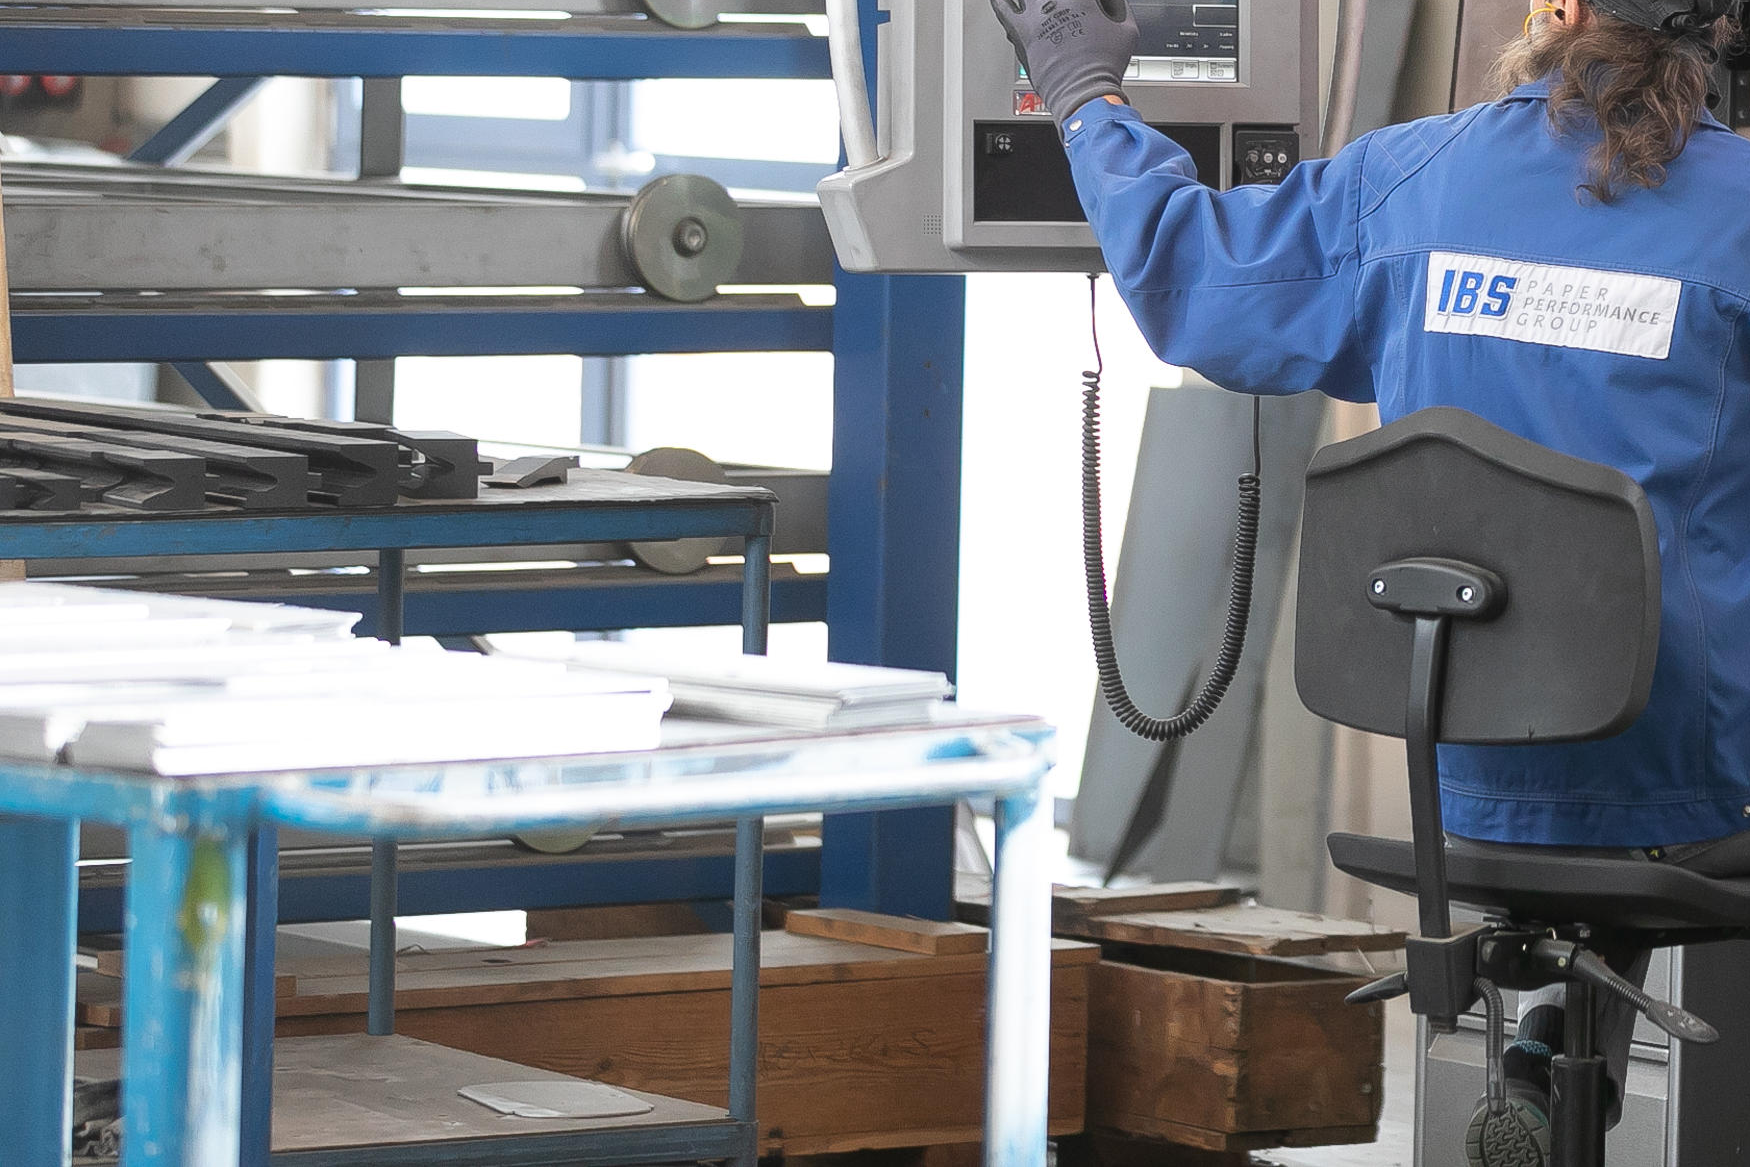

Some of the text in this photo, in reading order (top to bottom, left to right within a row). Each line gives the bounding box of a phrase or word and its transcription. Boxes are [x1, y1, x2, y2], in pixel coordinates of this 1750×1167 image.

[1437, 269, 1518, 317] IBS
[1526, 280, 1609, 301] PAPER
[1516, 313, 1599, 334] GROUP
[1523, 297, 1662, 326] PERFORMANCE
